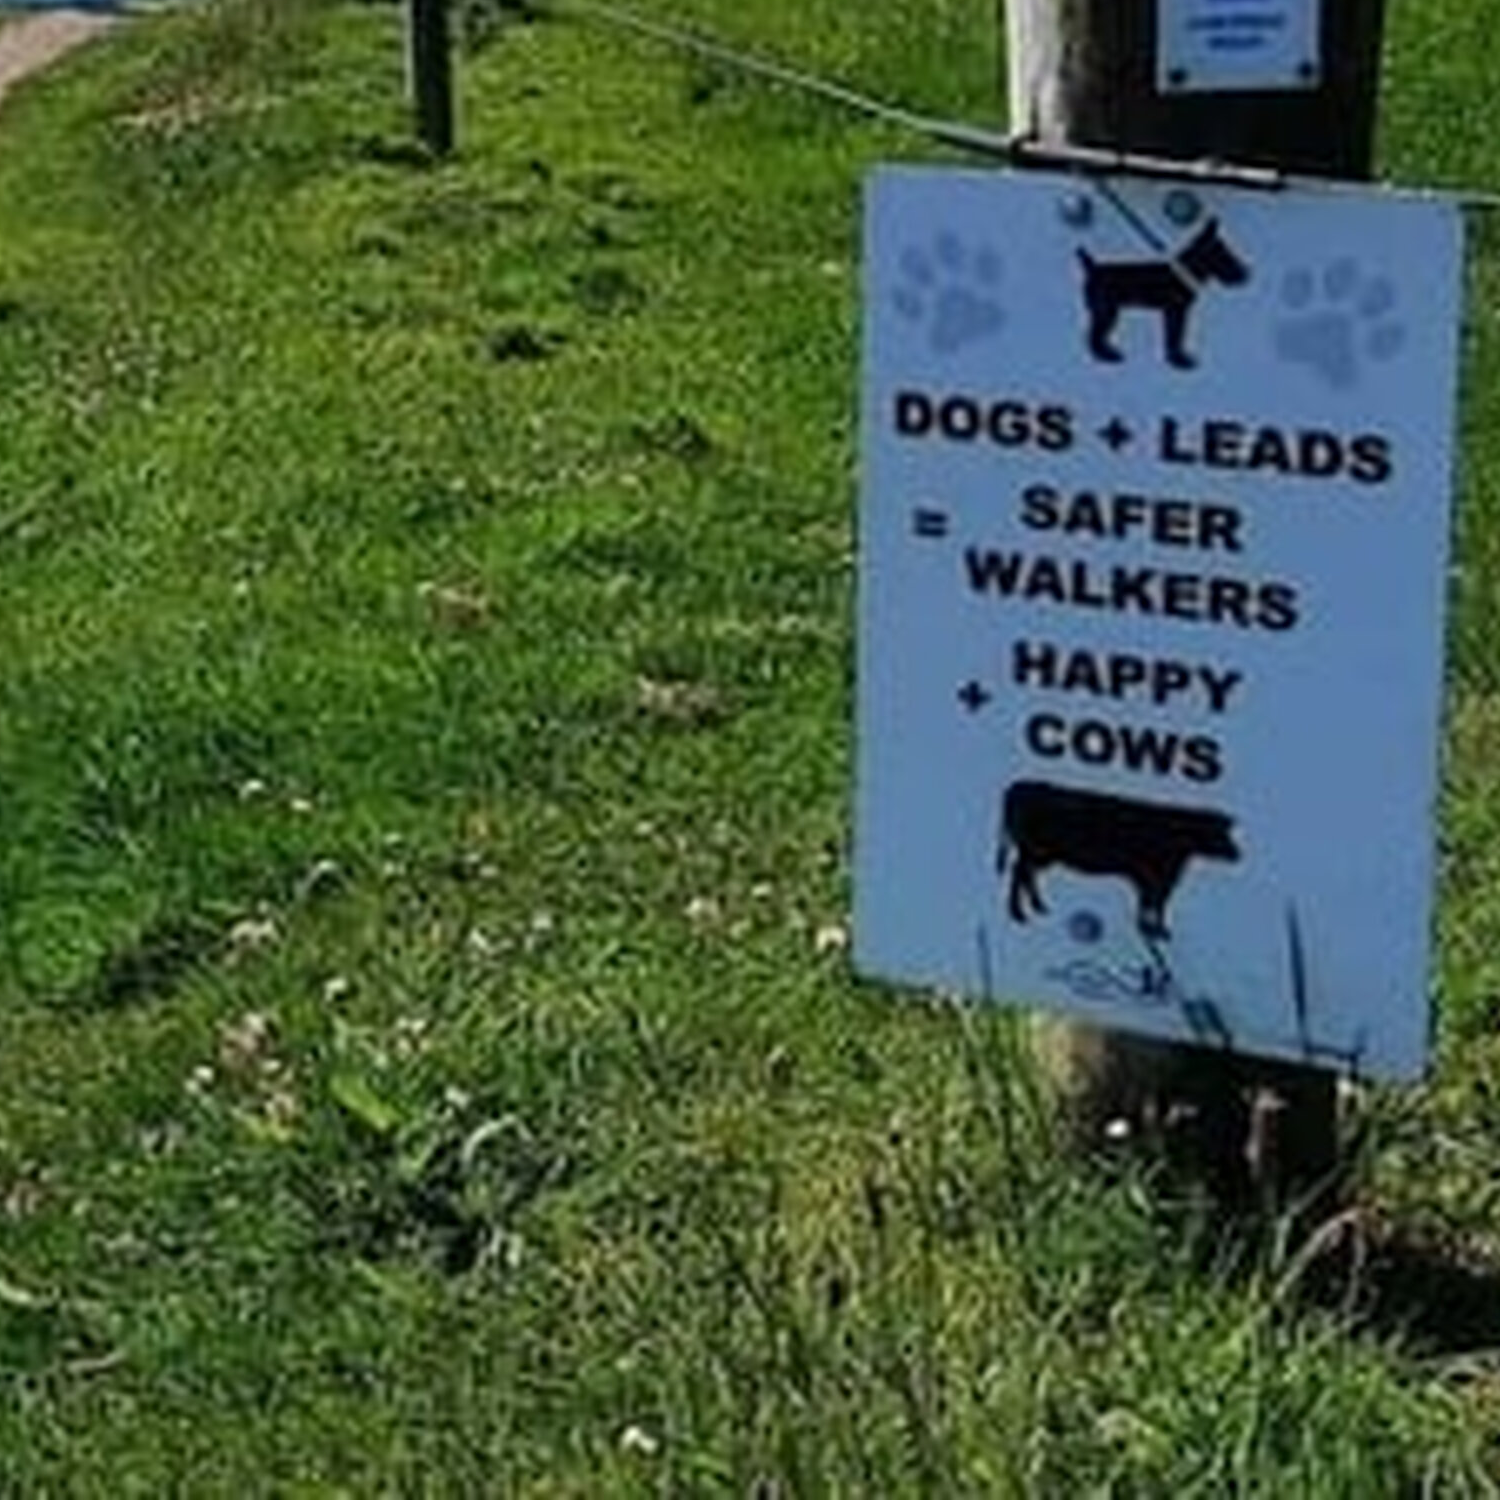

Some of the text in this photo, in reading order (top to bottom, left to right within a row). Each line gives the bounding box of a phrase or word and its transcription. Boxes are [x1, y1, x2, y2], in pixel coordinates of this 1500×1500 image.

[893, 391, 1393, 484] DOGS + LEADS
[1019, 485, 1244, 552] SAFER
[965, 547, 1299, 631] WALKERS
[1011, 640, 1243, 711] HAPPY
[1025, 714, 1224, 783] COWS
